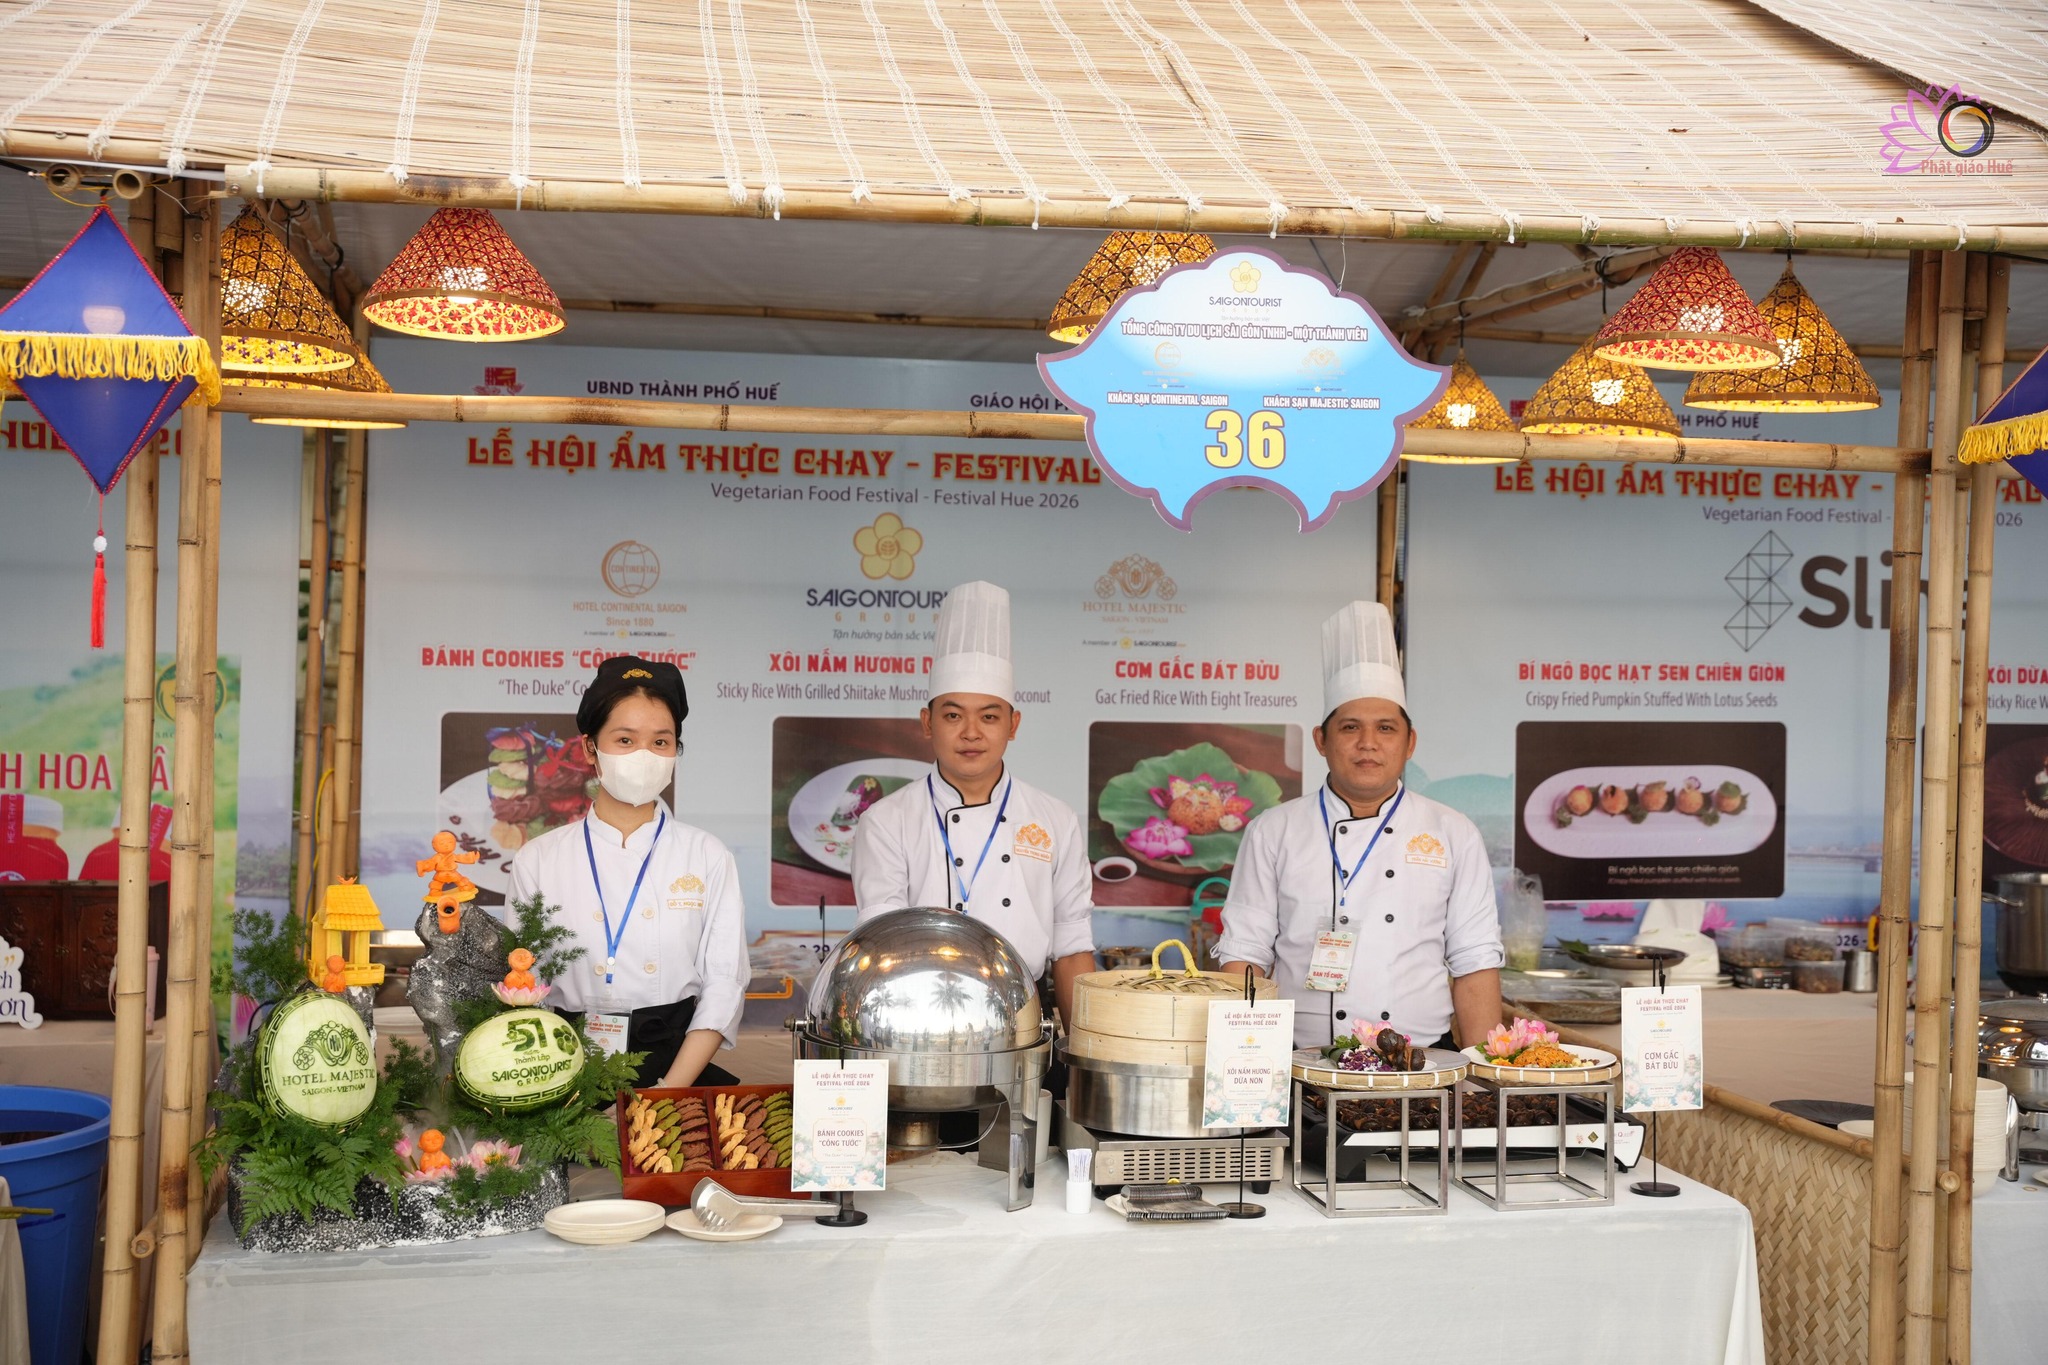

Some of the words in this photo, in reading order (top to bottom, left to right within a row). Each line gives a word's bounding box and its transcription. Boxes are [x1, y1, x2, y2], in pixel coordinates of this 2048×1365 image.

[1208, 296, 1282, 307] SAIGONTOURIST
[1148, 320, 1173, 336] CÔNG
[1175, 323, 1186, 337] TY
[1187, 324, 1200, 337] DU
[1201, 324, 1222, 341] LỊCH
[1223, 321, 1240, 339] SÀI
[1241, 322, 1260, 339] GÒN
[1261, 325, 1286, 340] TNHH
[1293, 324, 1314, 343] MỘT
[1315, 323, 1345, 341] THÀNH
[1346, 325, 1368, 342] VIÊN
[587, 381, 634, 396] UBND
[639, 380, 697, 398] THÀNH
[703, 381, 740, 400] PHỐ
[745, 382, 781, 401] HUẾ
[1107, 390, 1133, 404] KHÁCH
[1150, 393, 1199, 406] CONTINENTAL
[1200, 394, 1228, 406] SAIGON
[970, 394, 1014, 409] GIÁO
[1019, 396, 1049, 413] HỘI
[1263, 395, 1290, 408] KHÁCH
[1309, 397, 1349, 409] MAJESTIC
[1350, 398, 1380, 410] SAIGON
[1731, 412, 1762, 428] HUẾ
[1204, 408, 1287, 470] 36
[467, 427, 514, 466] LỄ
[526, 433, 598, 475] HỘI
[608, 430, 667, 471] ẨM
[679, 442, 780, 480] THỰC
[793, 448, 894, 478] CHAY
[932, 452, 1100, 484] FESTIVAL
[1545, 462, 1605, 500] HỘI
[1675, 467, 1761, 503] THỰC
[1773, 473, 1861, 500] CHAY
[711, 483, 803, 502] Vegetarian
[809, 485, 850, 502] Food
[856, 487, 919, 503] Festival
[934, 489, 997, 506] Festival
[1001, 491, 1034, 507] Hue
[1039, 493, 1079, 508] 2026
[1703, 506, 1783, 524] Vegetarian
[1786, 507, 1824, 523] Food
[1828, 508, 1882, 524] Festival
[1995, 511, 2024, 527] 026
[573, 601, 599, 612] HOTEL
[600, 602, 654, 613] CONTINENTAL
[657, 603, 687, 613] SAIGON
[806, 588, 948, 609] SAIGONTOUR
[1082, 602, 1124, 612] HOTEL
[1128, 603, 1187, 614] MAJESTIC
[606, 616, 631, 627] Since
[634, 617, 654, 627] 1880
[422, 645, 475, 667] BÁNH
[769, 651, 800, 672] XÔI
[1115, 660, 1152, 678] CƠM
[1201, 660, 1238, 680] BÁT
[1519, 660, 1535, 681] BÍ
[1541, 661, 1573, 681] NGÔ
[1580, 664, 1612, 684] BỌC
[1618, 664, 1652, 684] HẠT
[1658, 664, 1689, 682] SEN
[1696, 661, 1743, 682] CHIÊN
[1750, 662, 1786, 682] GIÒN
[717, 682, 750, 702] Sticky
[752, 683, 774, 700] Rice
[776, 683, 803, 700] With
[804, 683, 842, 701] Grilled
[843, 684, 887, 702] Shiitake
[888, 684, 929, 702] Mushro
[1014, 689, 1051, 703] oconut
[1095, 689, 1118, 705] Gac
[1120, 689, 1150, 706] Fried
[1153, 690, 1177, 706] Rice
[1180, 691, 1208, 707] With
[1211, 691, 1241, 711] Eight
[1243, 692, 1298, 708] Treasures
[1526, 691, 1560, 710] Crispy
[1561, 691, 1589, 707] Fried
[1592, 691, 1641, 710] Pumpkin
[1644, 691, 1684, 707] Stuffed
[1685, 691, 1712, 708] With
[1715, 692, 1743, 708] Lotus
[1746, 692, 1778, 708] Seeds
[1988, 694, 2012, 713] ticky
[2015, 694, 2037, 709] Rice
[39, 753, 112, 791] HOA
[508, 1017, 549, 1052] 51
[282, 1072, 327, 1086] HOTEL
[330, 1068, 376, 1082] MAJESTIC
[491, 1059, 573, 1083] SAIGONTOURIST
[517, 1073, 555, 1087] GROUP
[301, 1086, 333, 1096] SAIGON
[337, 1083, 366, 1093] VIETNAM
[836, 1129, 864, 1137] COOKIES
